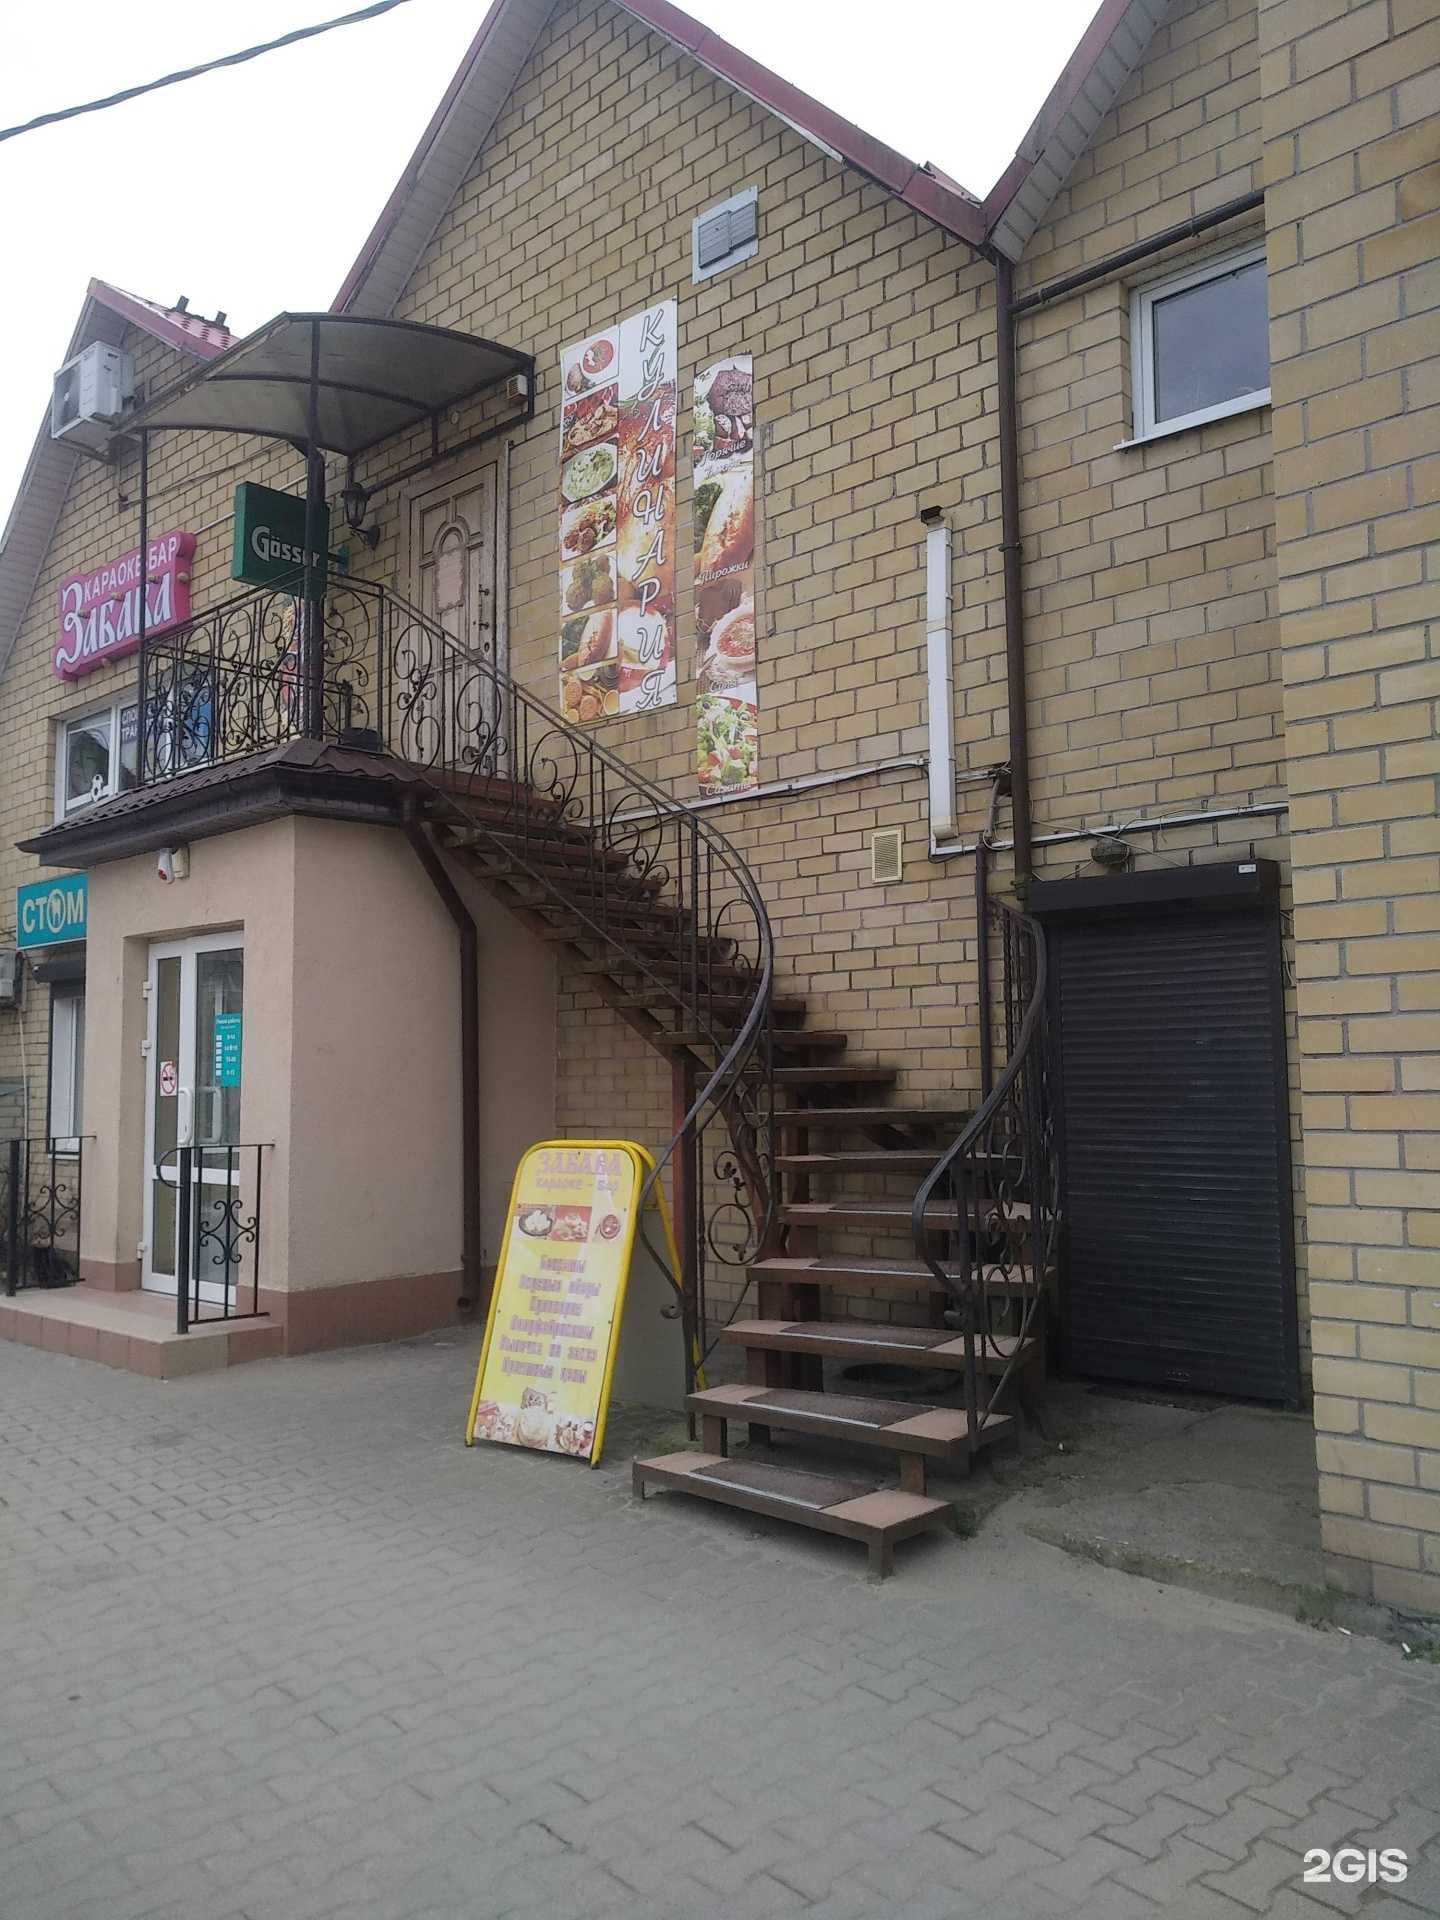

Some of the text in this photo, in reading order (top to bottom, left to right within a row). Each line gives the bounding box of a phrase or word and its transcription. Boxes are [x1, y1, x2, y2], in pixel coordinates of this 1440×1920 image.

[631, 308, 667, 711] КУЛИНАРИЯ
[84, 536, 177, 603] КАРАОКЕ БАР
[699, 560, 749, 582] Пирожки
